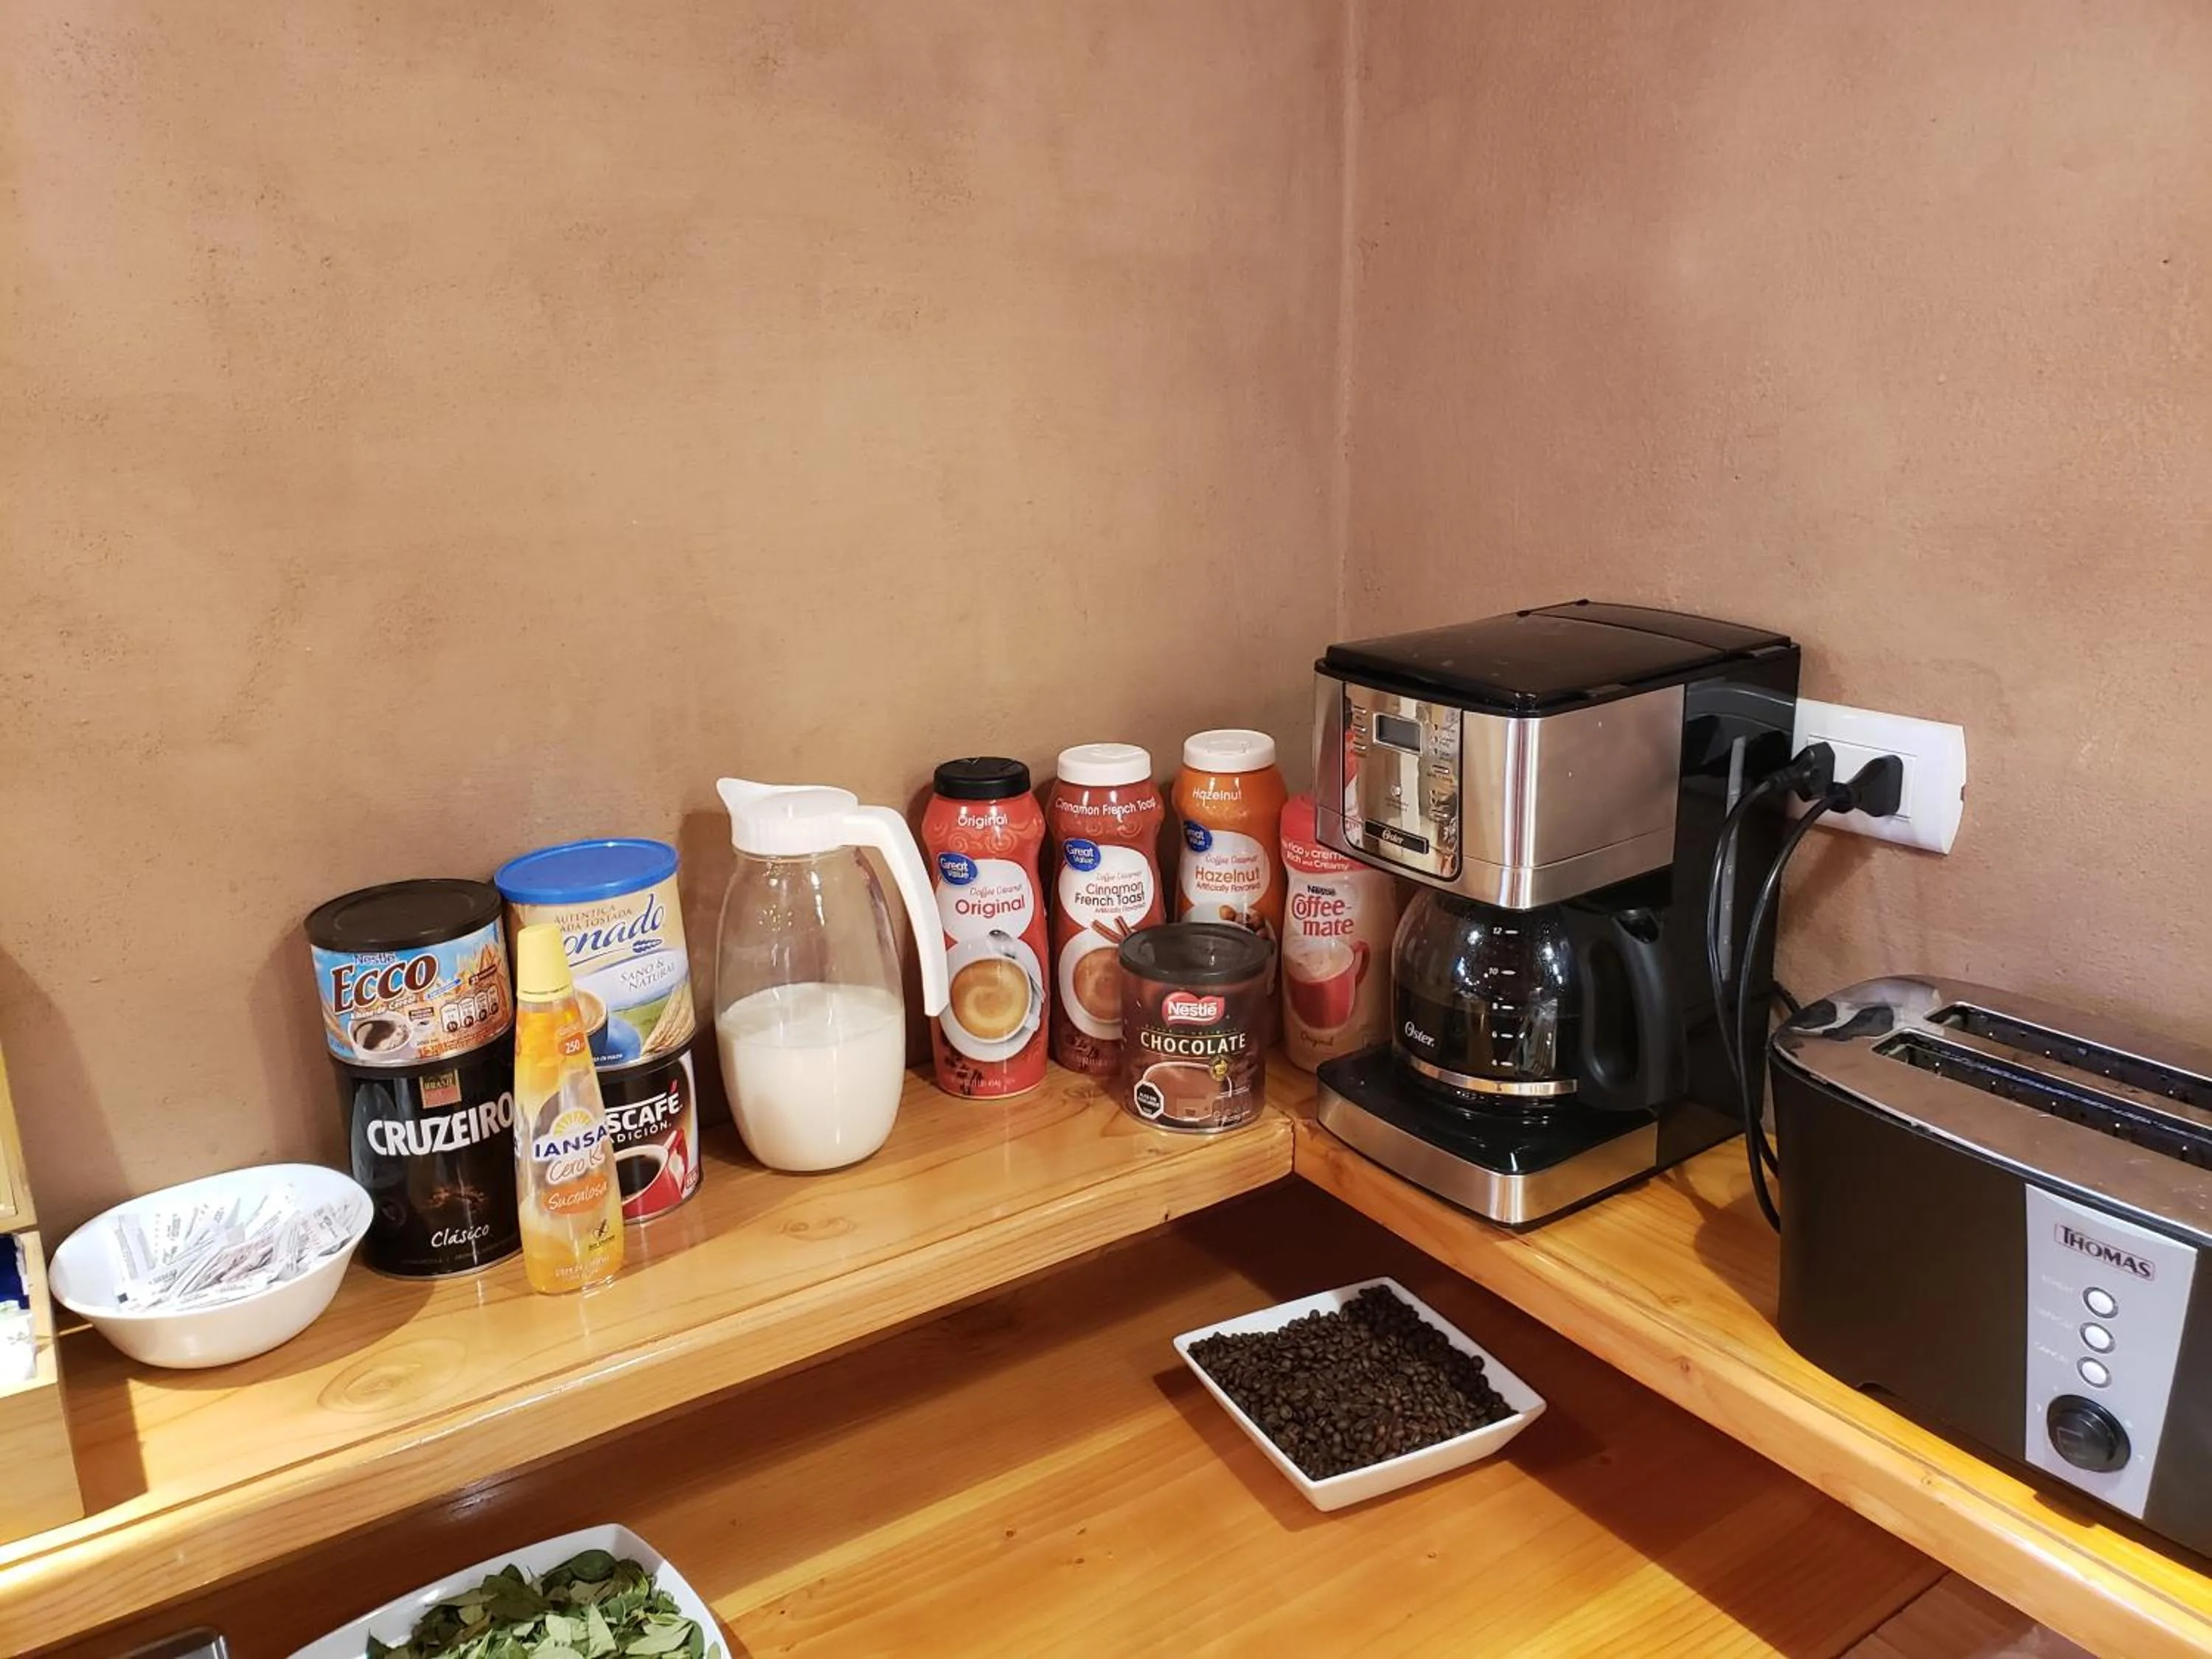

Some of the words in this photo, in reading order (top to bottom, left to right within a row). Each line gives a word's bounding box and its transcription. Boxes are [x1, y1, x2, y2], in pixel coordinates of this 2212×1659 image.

[1192, 788, 1242, 801] Hazelnut
[1055, 797, 1099, 816] Cinnamon
[1103, 803, 1136, 816] French
[1138, 796, 1156, 810] Toast
[958, 813, 1008, 829] Original
[1066, 844, 1093, 858] Great
[1311, 849, 1345, 860] crem
[940, 858, 967, 871] Great
[1314, 859, 1350, 870] Creamy
[1195, 866, 1259, 883] Hazelnut
[1086, 881, 1144, 896] Cinnamon
[1074, 893, 1114, 906] French
[1116, 890, 1145, 905] Toast
[956, 896, 1026, 918] Original
[560, 923, 582, 933] ADA
[563, 893, 664, 956] onado
[1303, 917, 1354, 937] mate
[1492, 927, 1503, 935] 12
[621, 964, 653, 982] SANO
[1489, 967, 1498, 975] 10
[1141, 1032, 1247, 1055] CHOCOLATE
[606, 1079, 680, 1134] SCAFÉ
[366, 1091, 513, 1156] CRUZEIRO
[535, 1124, 608, 1158] IANSA
[549, 1158, 585, 1182] Cero
[588, 1144, 602, 1166] K
[431, 1224, 490, 1248] Clásico
[2062, 1226, 2152, 1278] THOMAS
